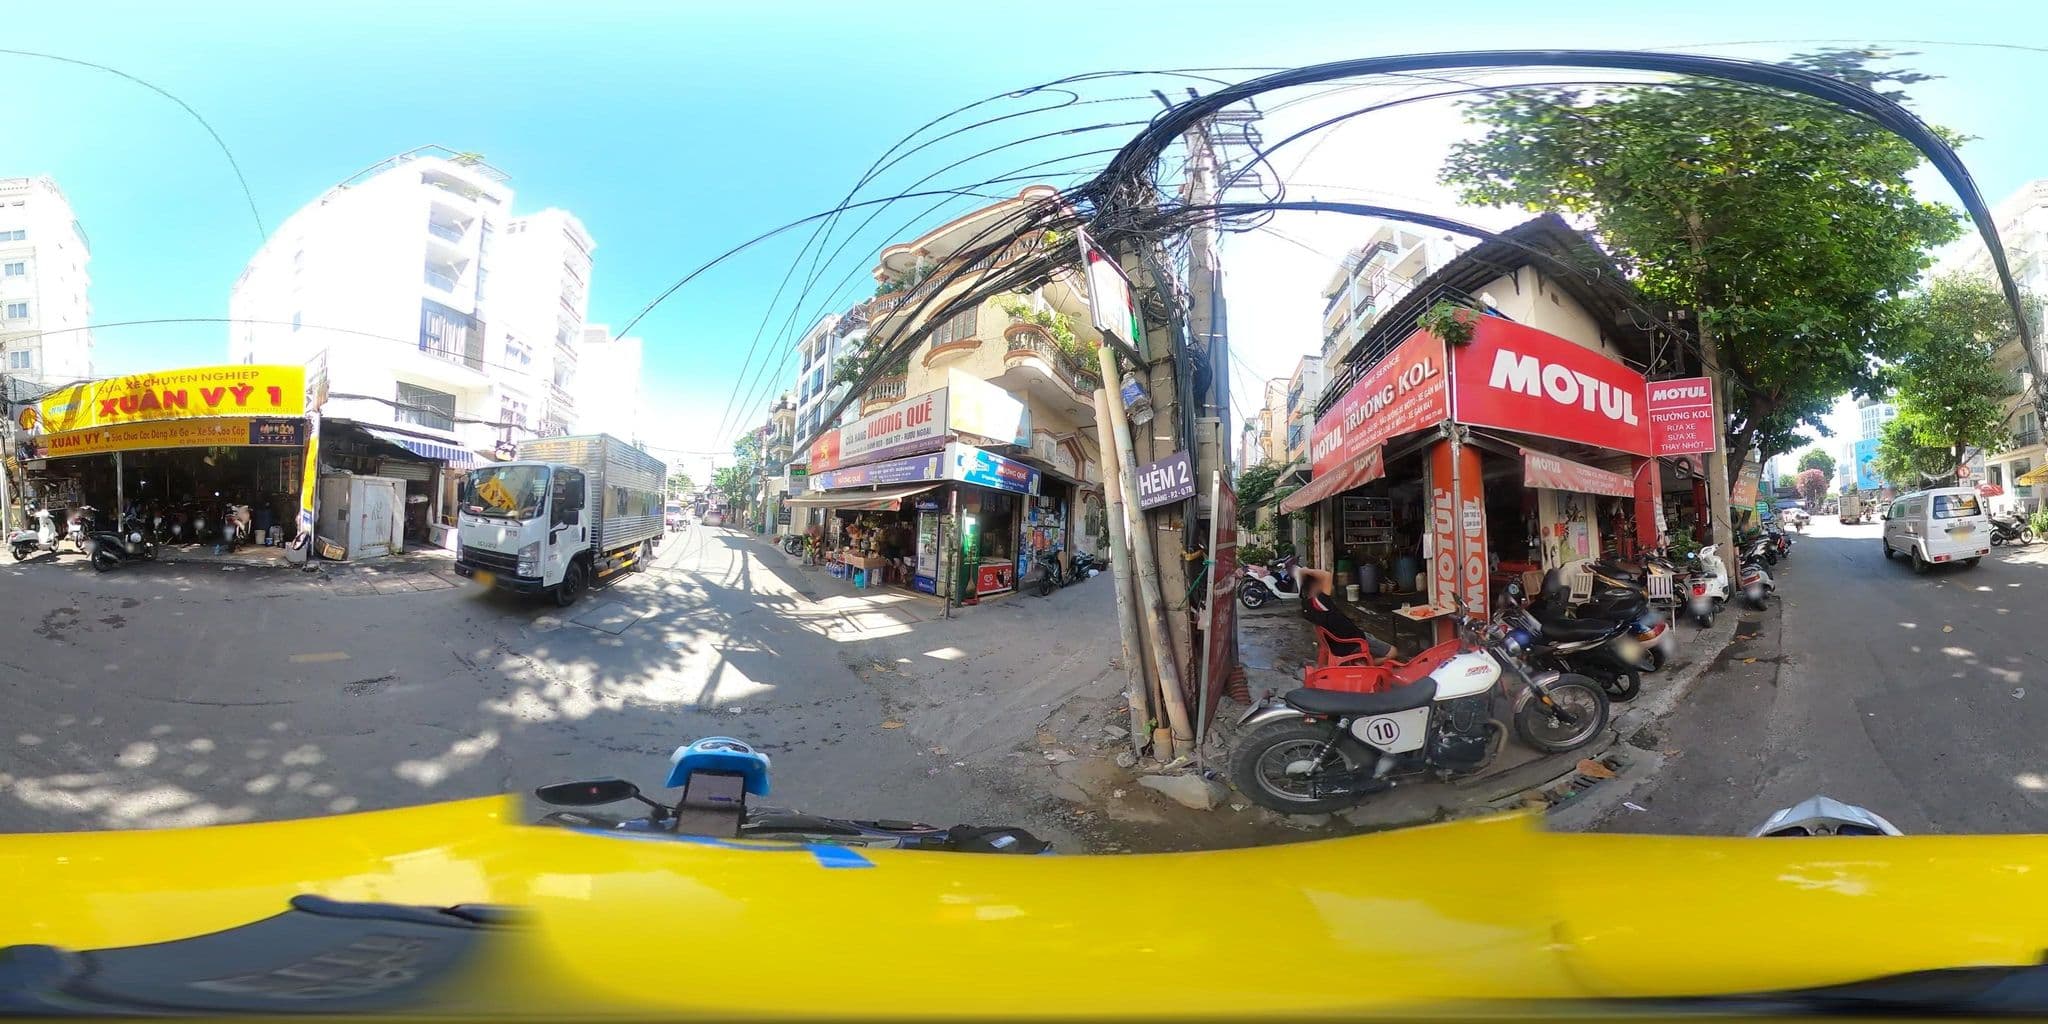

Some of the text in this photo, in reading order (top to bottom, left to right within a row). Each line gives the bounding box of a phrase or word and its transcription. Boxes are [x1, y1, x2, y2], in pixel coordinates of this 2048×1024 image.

[1398, 357, 1439, 396] KOL
[1489, 349, 1639, 426] MOTUL
[267, 385, 282, 407] 1
[1653, 385, 1708, 402] MOTUL
[906, 395, 933, 428] QUÊ
[1692, 410, 1711, 419] KOL
[1313, 425, 1343, 464] MOTUL
[1686, 431, 1697, 439] XE
[1661, 442, 1681, 451] THAY
[1530, 455, 1561, 474] MOTUL
[1139, 460, 1190, 496] HẺM 2
[1434, 488, 1456, 611] MOTUL
[1373, 721, 1394, 740] 10
